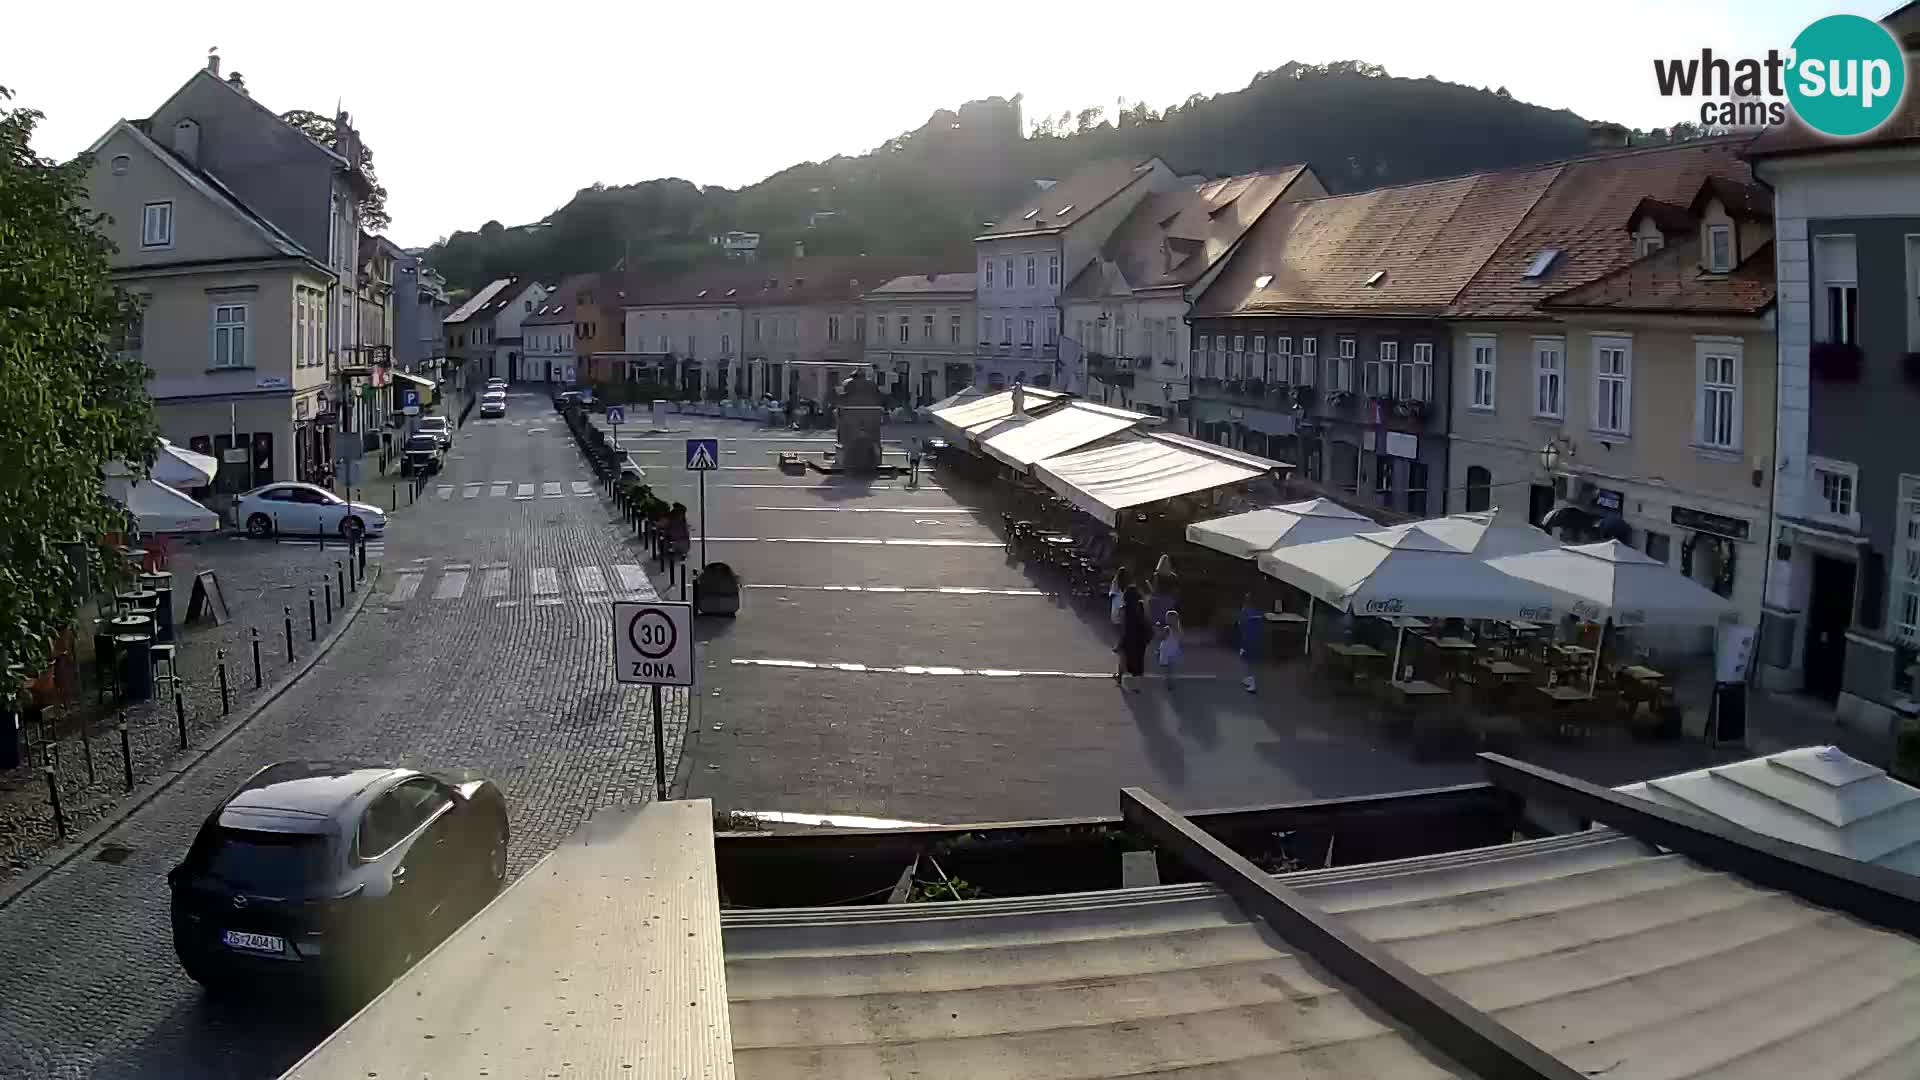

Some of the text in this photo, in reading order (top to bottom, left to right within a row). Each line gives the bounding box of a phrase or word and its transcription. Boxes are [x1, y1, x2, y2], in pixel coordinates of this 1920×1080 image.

[407, 393, 416, 404] P
[641, 624, 666, 645] 30
[631, 661, 676, 678] ZONA
